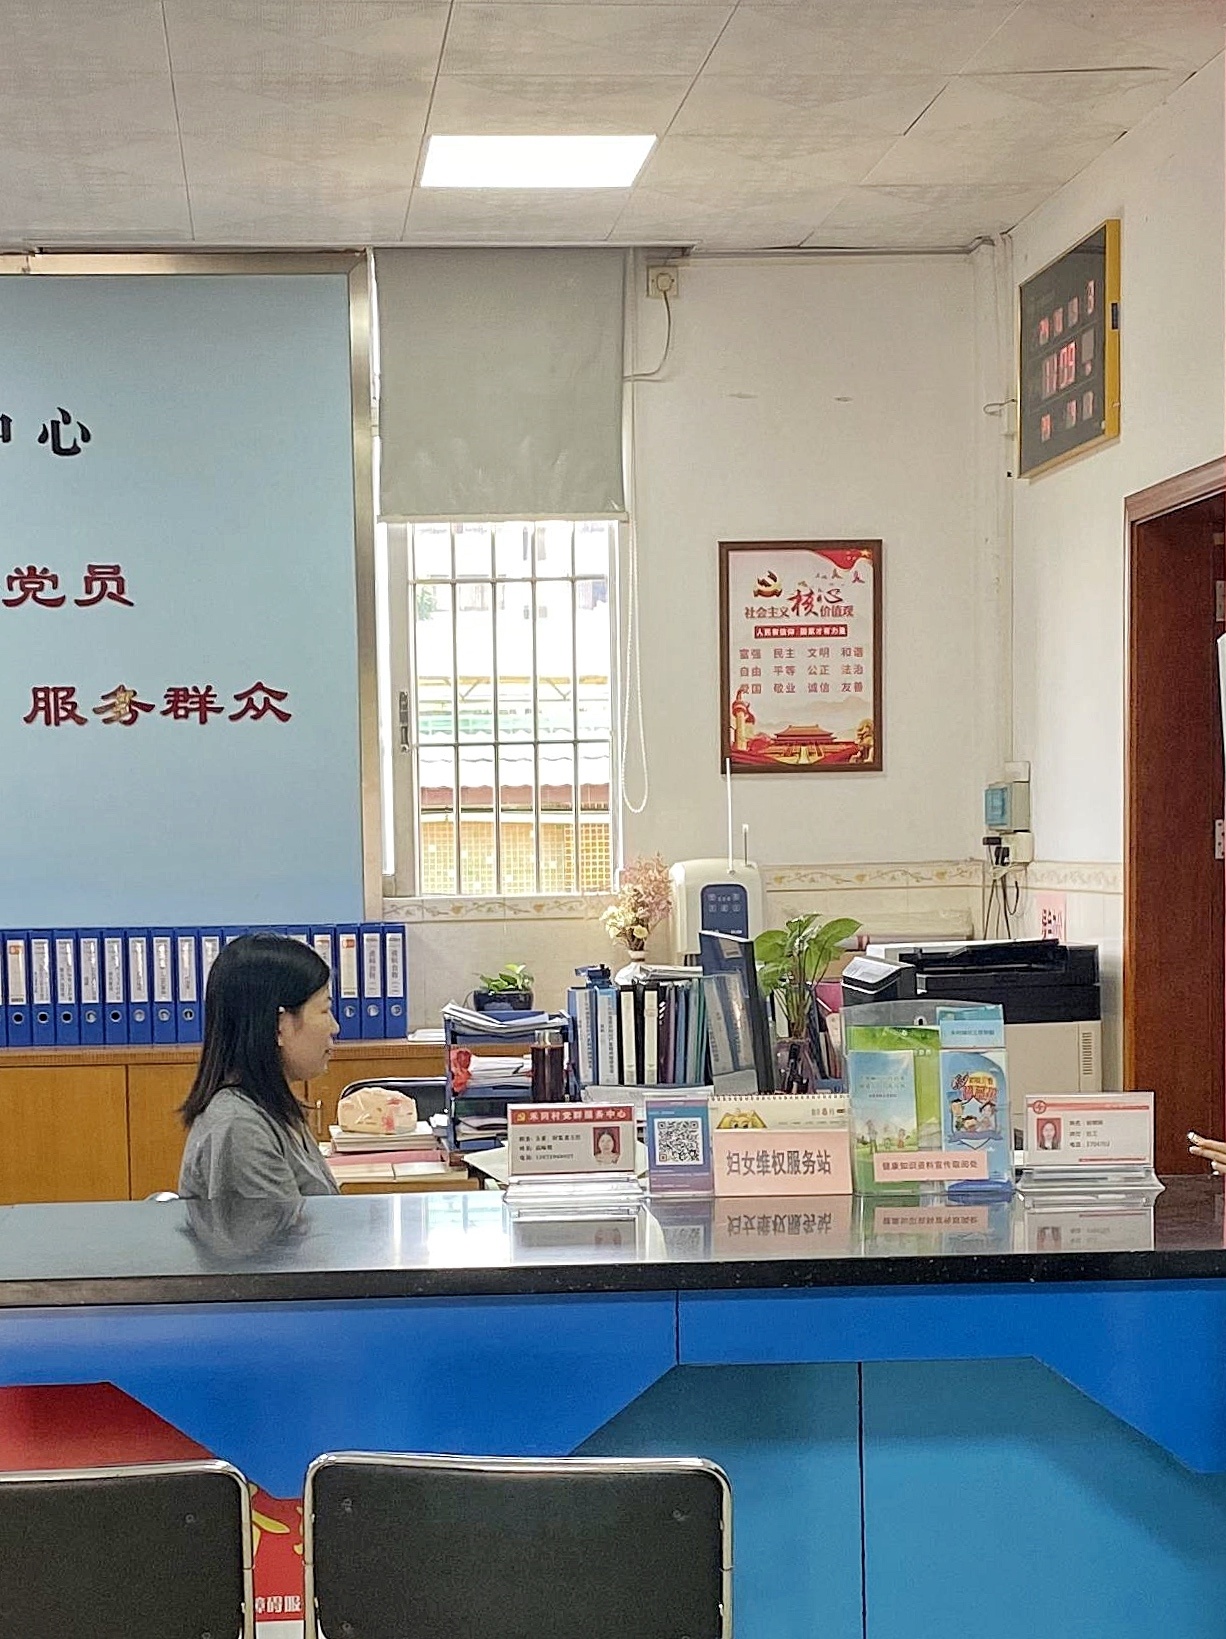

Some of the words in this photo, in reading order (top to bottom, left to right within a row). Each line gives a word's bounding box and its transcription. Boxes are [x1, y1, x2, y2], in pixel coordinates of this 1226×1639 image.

[0, 564, 134, 607] 党员
[740, 649, 762, 659] 富强
[773, 648, 795, 659] 民主
[807, 647, 829, 658] 文明
[841, 646, 863, 657] 和谐
[740, 666, 762, 677] 自由
[773, 665, 796, 676] 平等
[807, 665, 830, 676] 公正
[841, 664, 864, 675] 法治
[740, 683, 762, 694] 爱国
[773, 683, 796, 694] 敬业
[807, 682, 830, 693] 诚信
[841, 682, 863, 692] 友善
[23, 681, 292, 726] 服务群众
[726, 1149, 832, 1176] 妇女维权服务站
